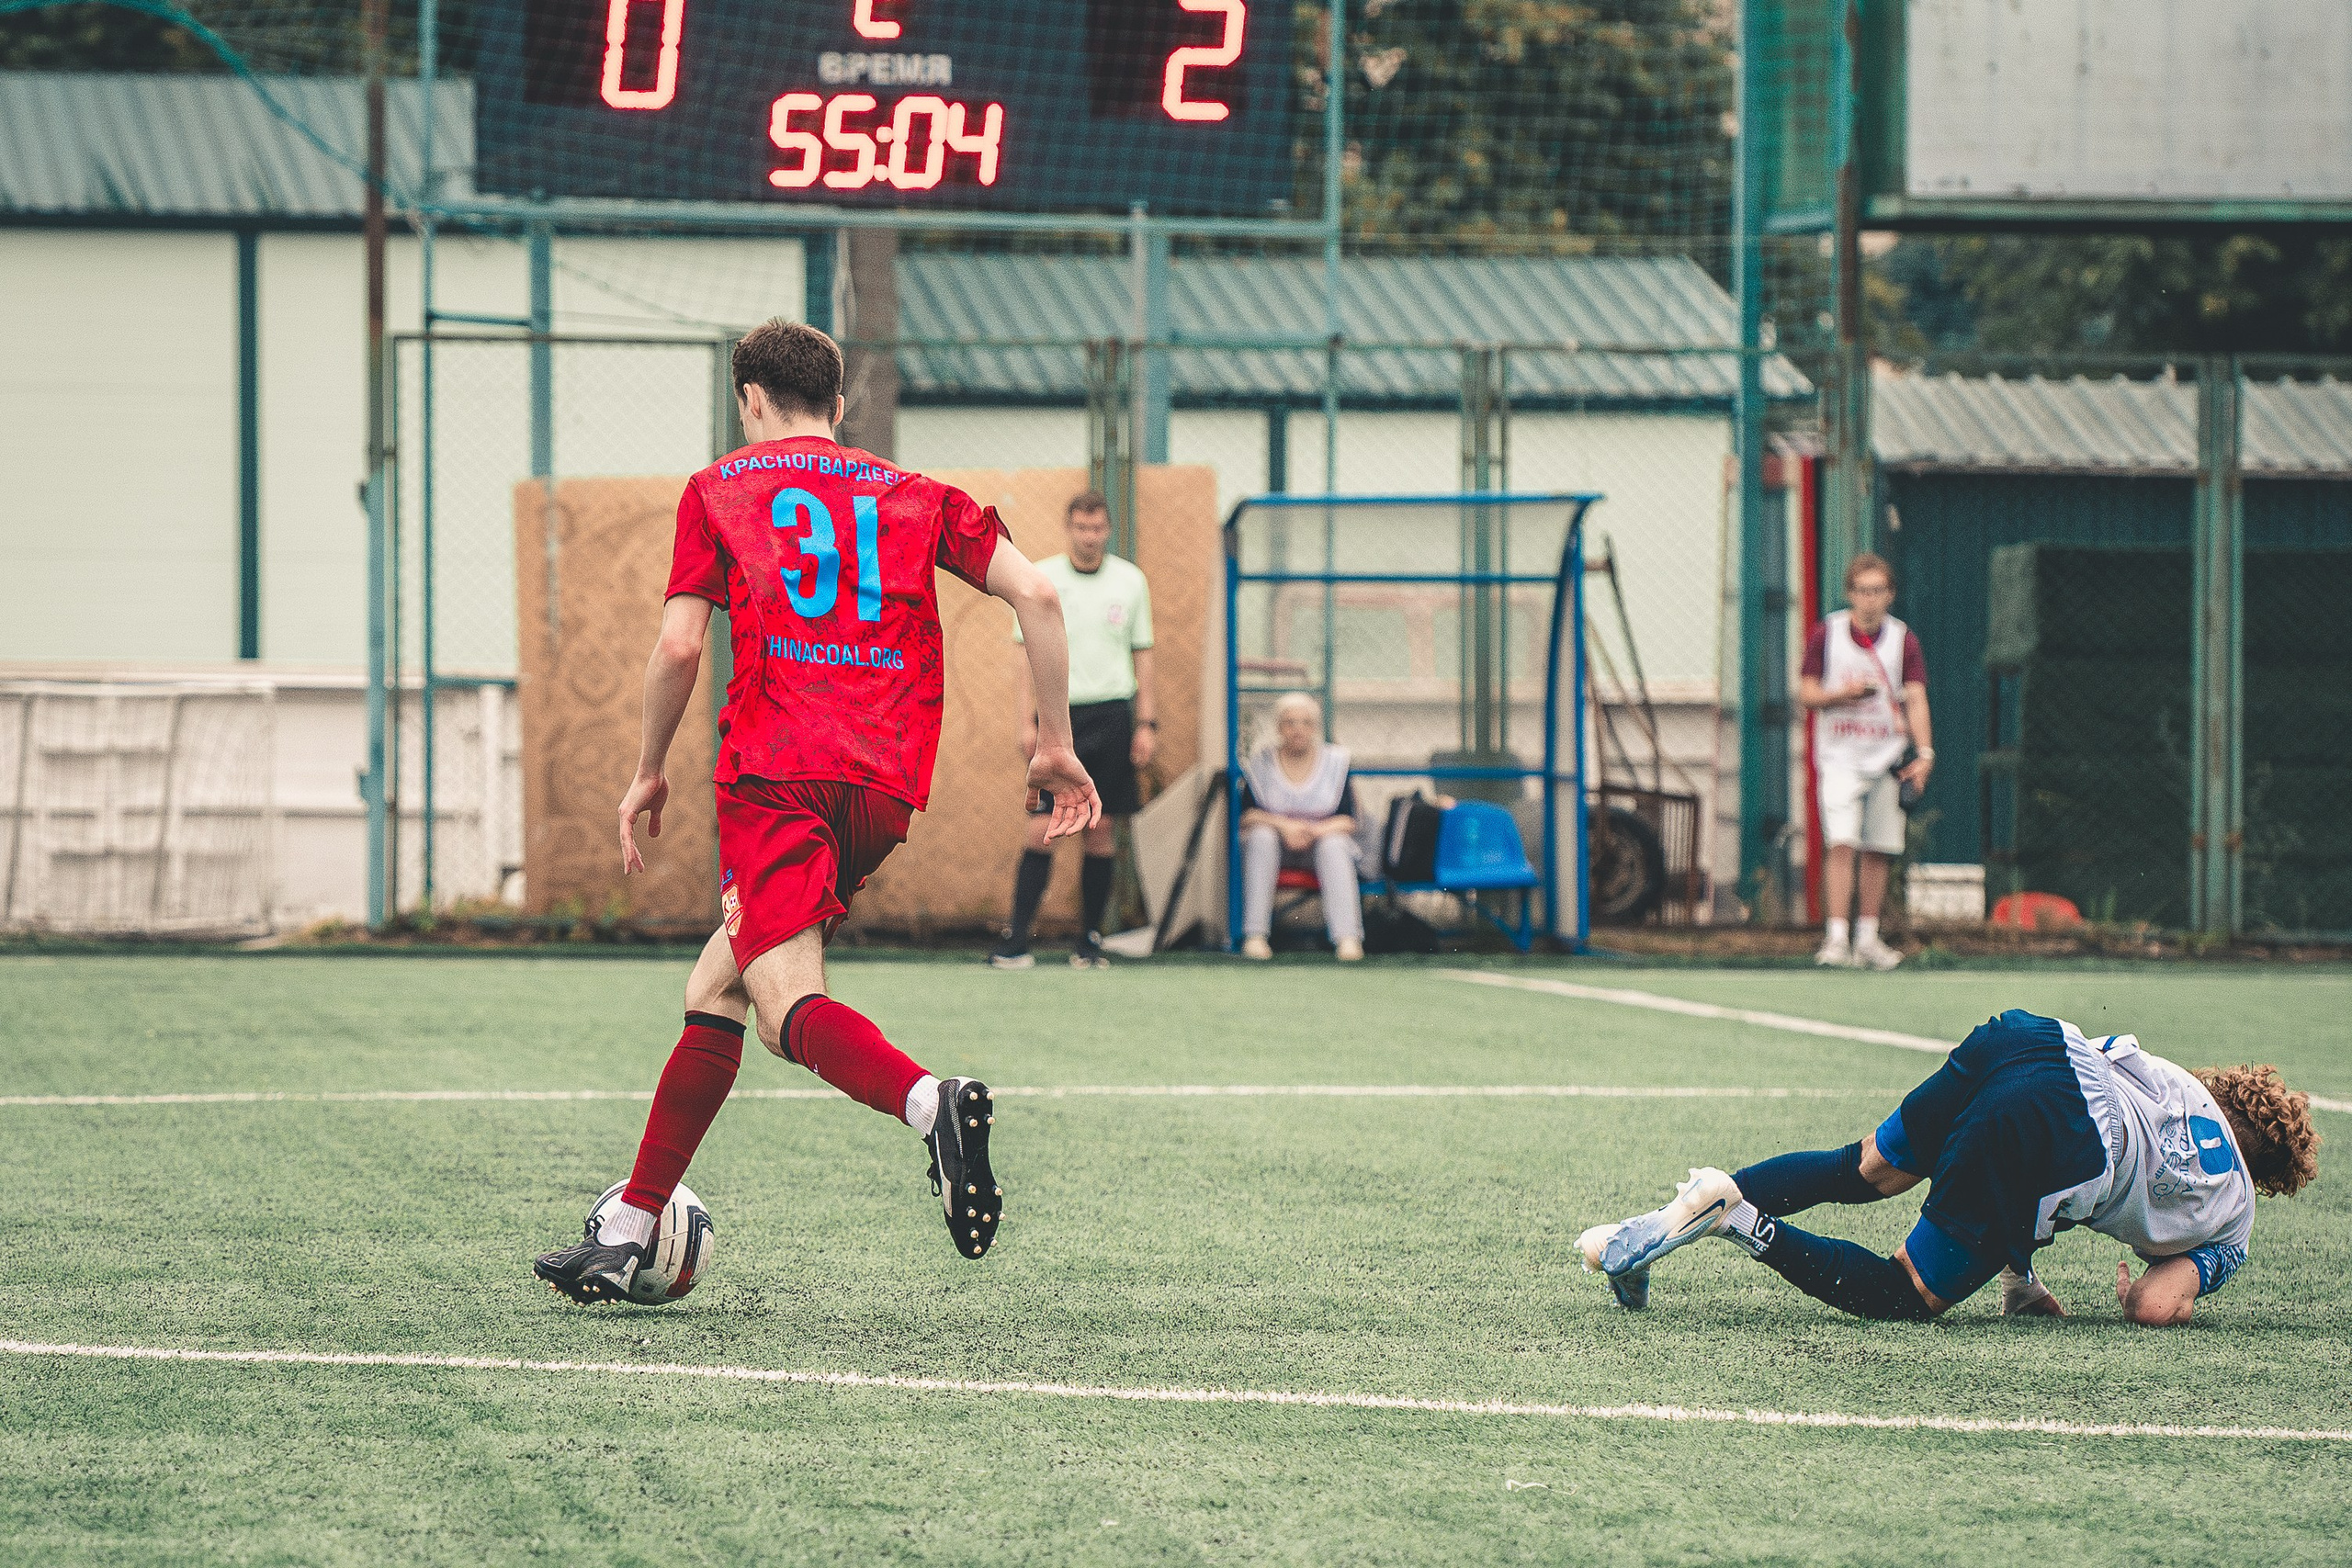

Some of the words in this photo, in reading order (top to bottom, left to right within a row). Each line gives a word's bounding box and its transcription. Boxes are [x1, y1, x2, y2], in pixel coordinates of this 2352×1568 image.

[600, 0, 685, 109] 0
[1161, 0, 1246, 121] 2
[768, 93, 1004, 190] 55:04
[771, 487, 883, 622] 31
[766, 635, 905, 670] HINACOAL.ORG
